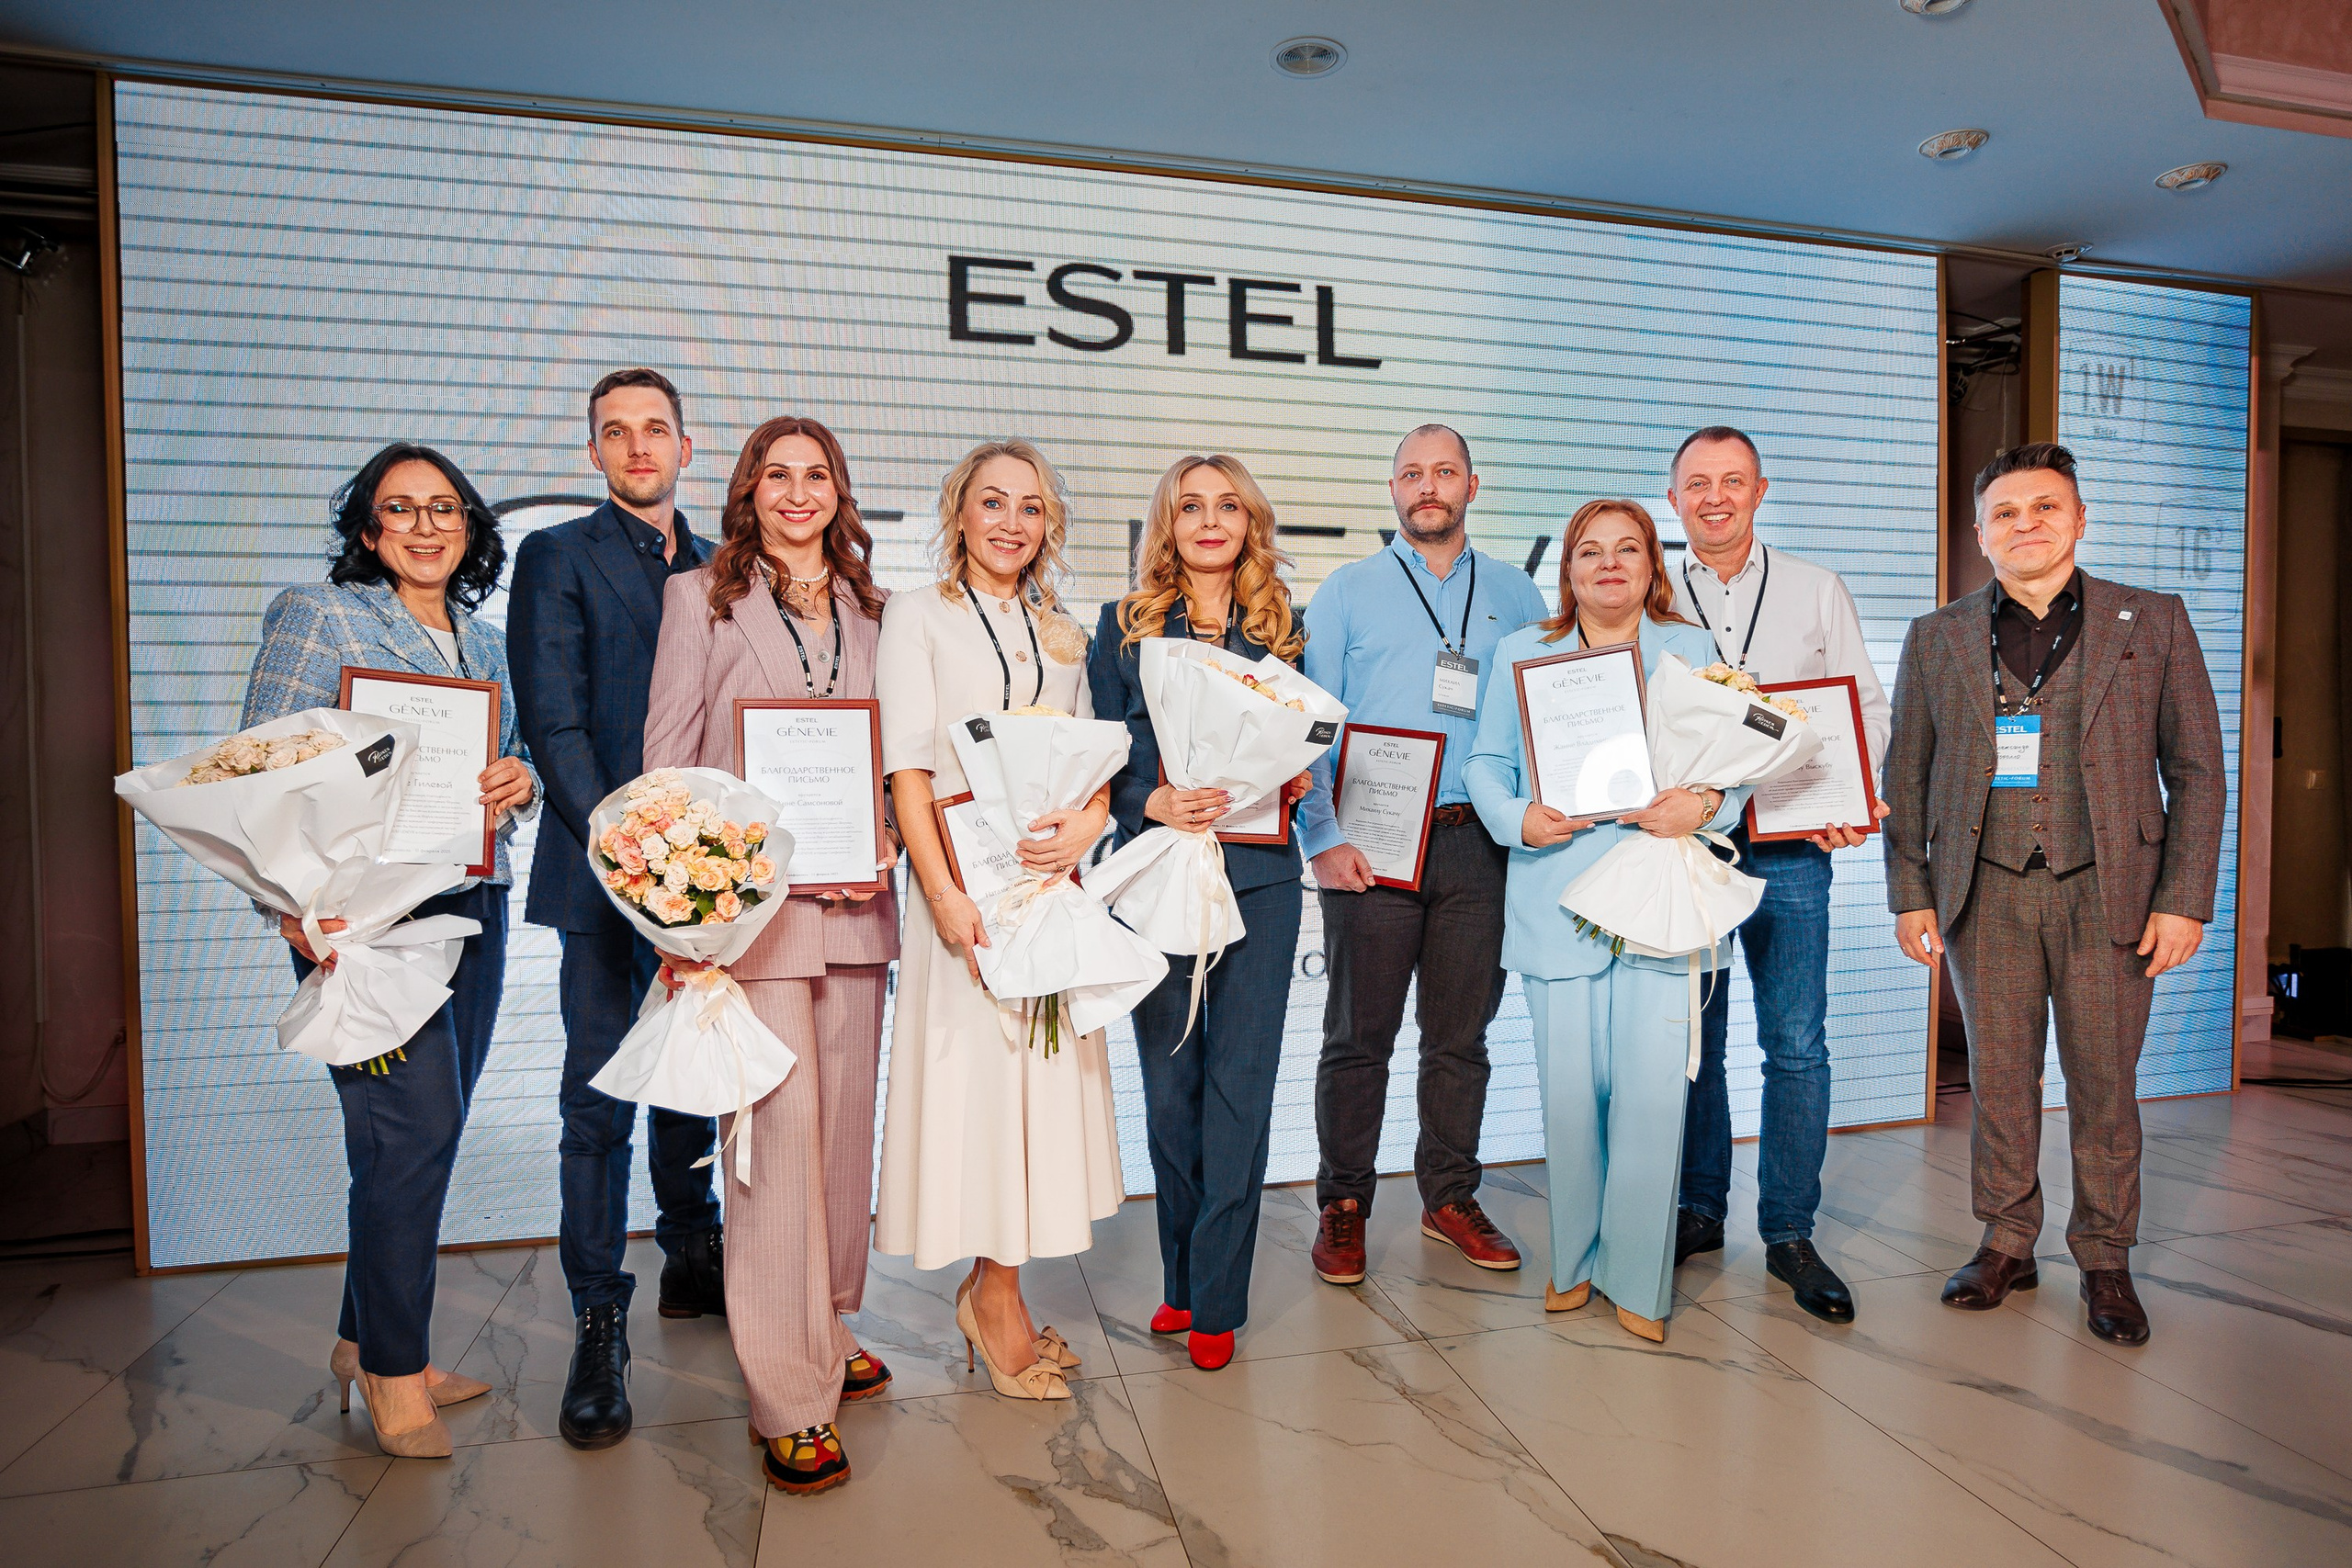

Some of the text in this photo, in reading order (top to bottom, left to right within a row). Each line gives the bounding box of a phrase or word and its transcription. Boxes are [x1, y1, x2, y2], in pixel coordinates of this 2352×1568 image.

[948, 255, 1382, 369] ESTEL
[798, 646, 807, 662] ESTEL
[1441, 660, 1468, 672] ESTEL
[1567, 667, 1588, 675] ESTEL
[1552, 672, 1606, 690] GÈNEVIE
[389, 704, 454, 718] GÈNEVIE
[1544, 705, 1625, 724] БЛАГОДАРСТВЕННОЕ
[1567, 716, 1604, 728] ПИСЬМО
[776, 726, 838, 737] GÈNEVIE
[419, 746, 469, 757] СТВЕННОЕ
[1368, 748, 1411, 761] GÈNEVIE
[761, 766, 855, 775] БЛАГОДАРСТВЕННОЕ
[413, 778, 453, 789] Гилевой
[787, 775, 831, 784] ПИСЬМО
[1352, 778, 1418, 793] БЛАГОДАРСТВЕННОЕ
[1368, 787, 1398, 797] ПИСЬМО
[972, 851, 1012, 869] БЛАГОДАР
[996, 859, 1019, 871] ПИСЬ
